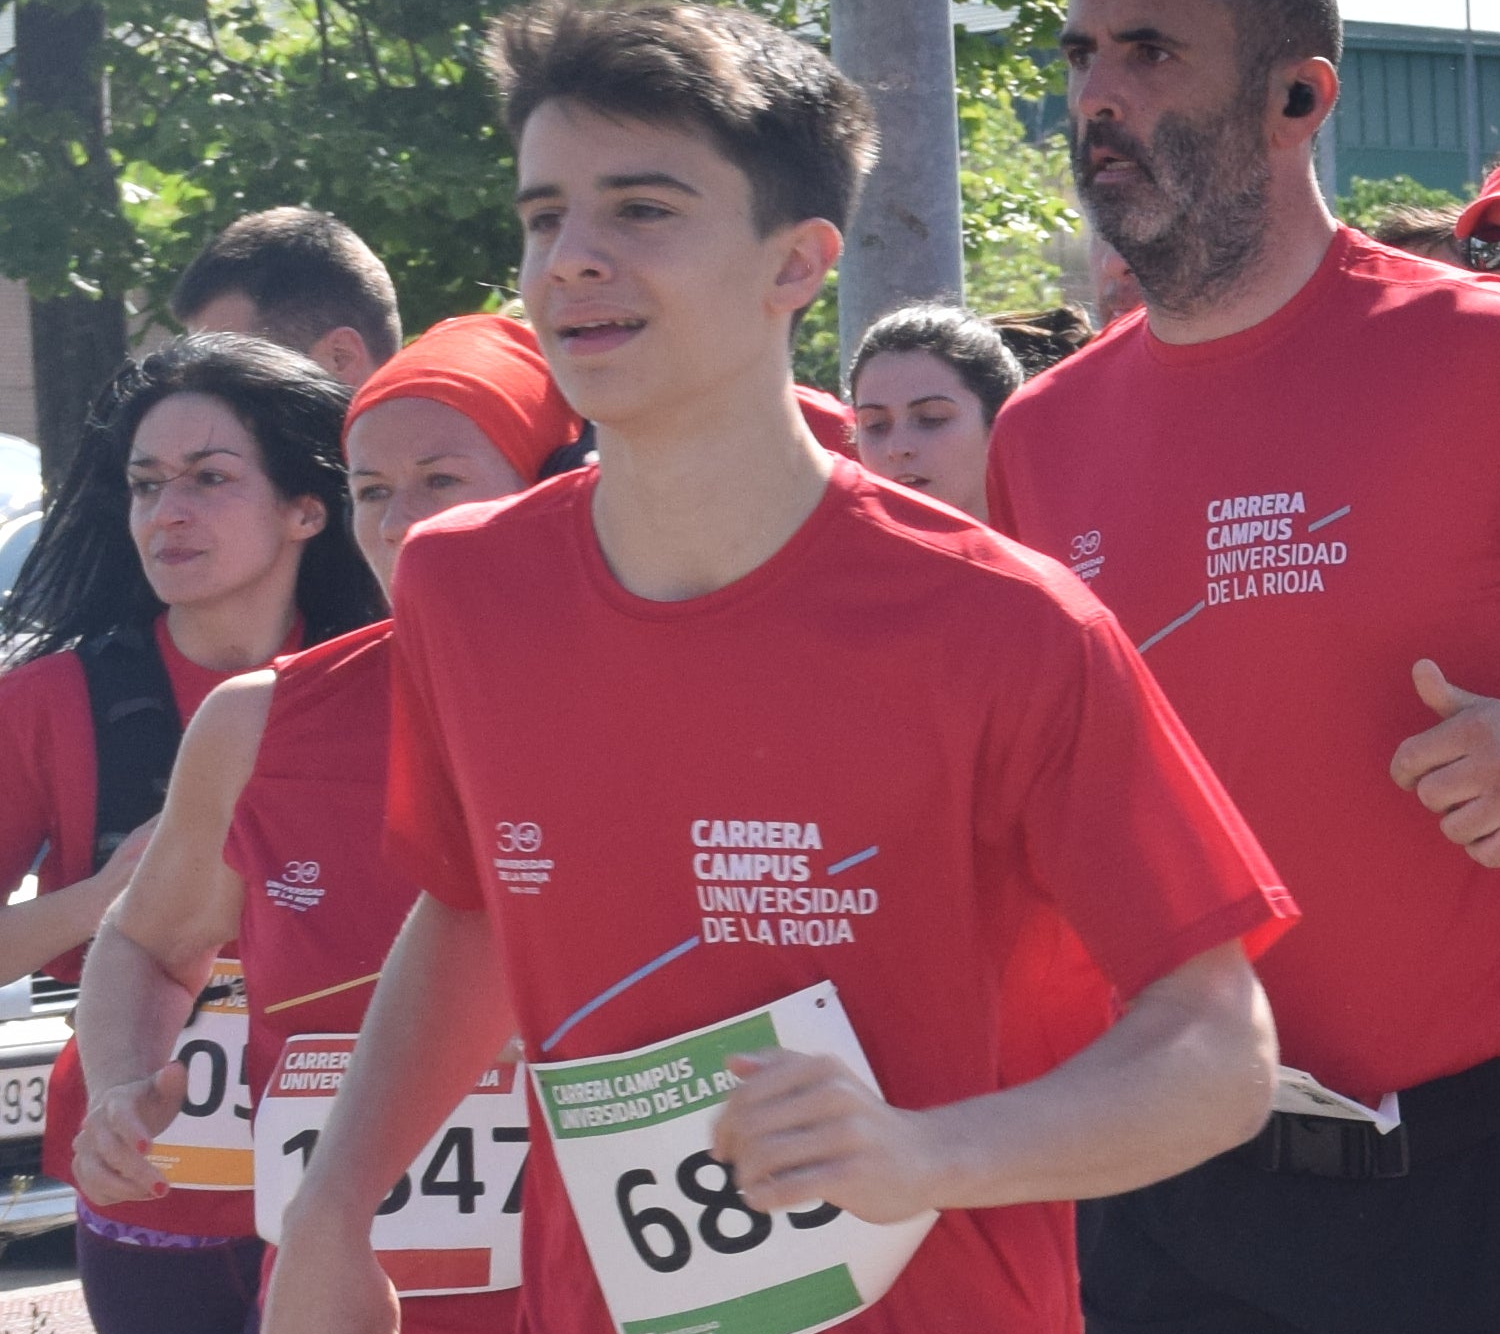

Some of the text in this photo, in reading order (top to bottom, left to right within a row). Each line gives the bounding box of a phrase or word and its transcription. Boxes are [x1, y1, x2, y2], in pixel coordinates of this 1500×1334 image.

[1207, 491, 1305, 523] CARRERA
[1206, 517, 1293, 550] CAMPUS
[1207, 541, 1347, 578] UNIVERSIDAD
[1208, 569, 1325, 606] DE LA RIOJA
[692, 819, 822, 850] CARRERA
[693, 853, 810, 882] CAMPUS
[698, 886, 878, 915] UNIVERSIDAD
[703, 917, 855, 946] DE LA RIOJA
[284, 1052, 351, 1069] CARRER
[279, 1072, 343, 1090] UNIVER
[552, 1076, 611, 1105] CARRERA
[614, 1056, 693, 1099] CAMPUS
[654, 1088, 682, 1114] DE
[684, 1080, 712, 1105] LA
[617, 1148, 843, 1273] 68
